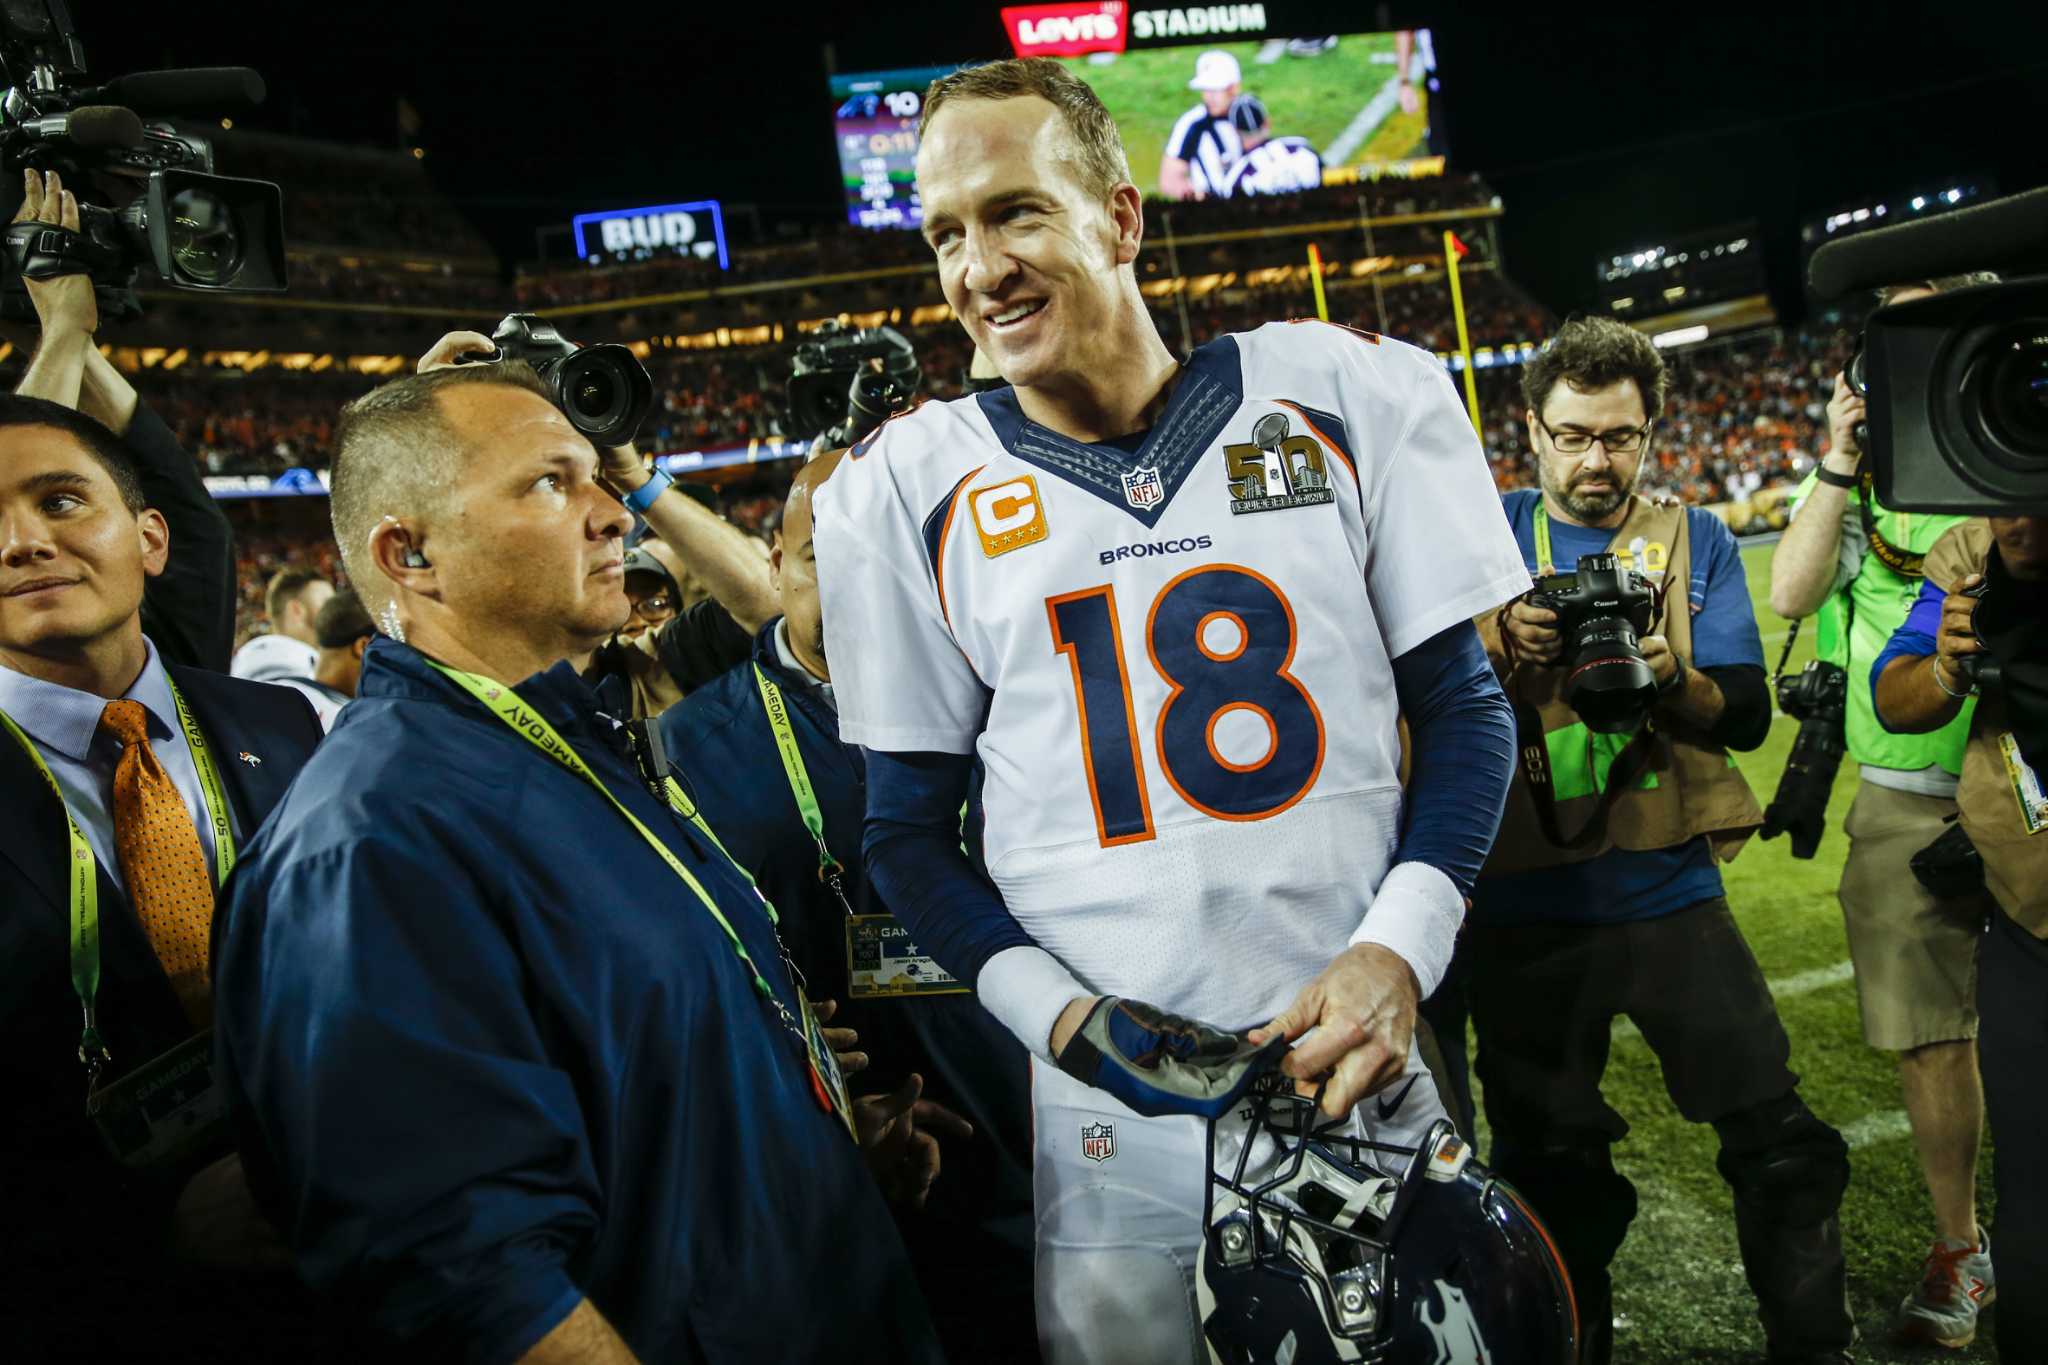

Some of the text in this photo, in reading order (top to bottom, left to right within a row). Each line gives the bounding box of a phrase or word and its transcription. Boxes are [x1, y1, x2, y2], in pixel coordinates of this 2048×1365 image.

[1133, 3, 1267, 38] STADIUM
[884, 90, 920, 117] 10
[601, 211, 696, 252] BUD
[1131, 484, 1158, 503] NFL
[1239, 492, 1326, 511] SUPER BOWL
[975, 482, 1037, 537] C
[1099, 535, 1213, 566] BRONCOS
[1045, 562, 1326, 848] 18
[215, 816, 228, 837] 50
[1086, 1138, 1111, 1158] NFL
